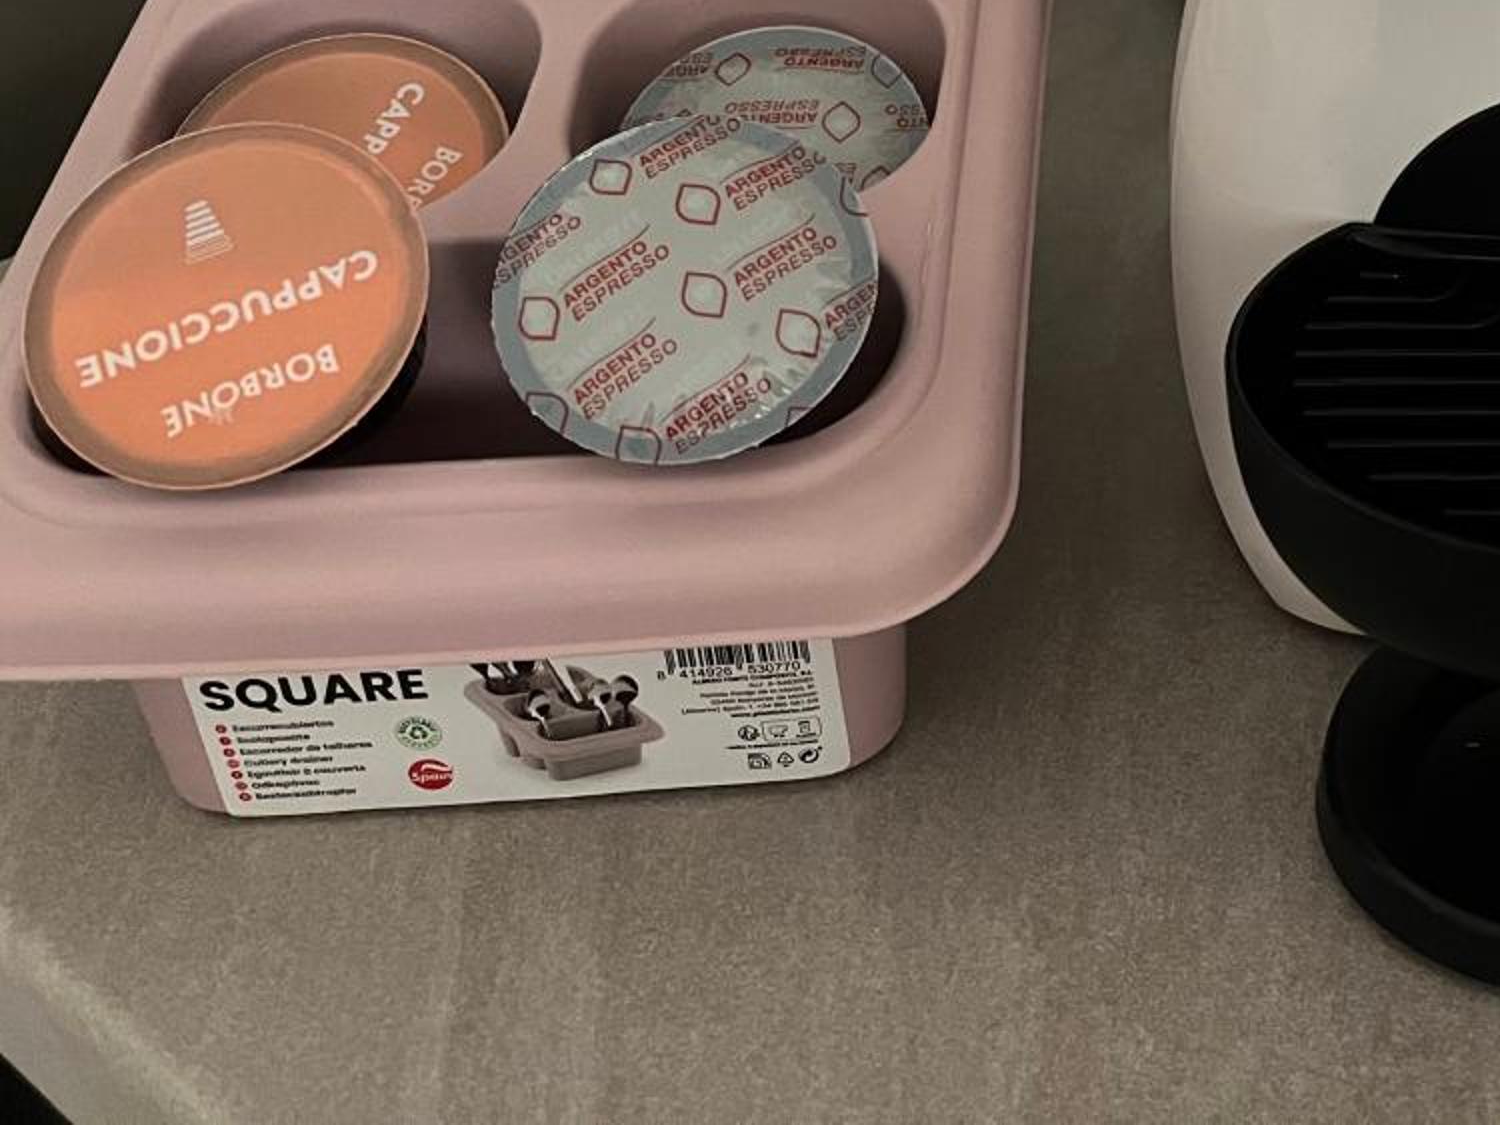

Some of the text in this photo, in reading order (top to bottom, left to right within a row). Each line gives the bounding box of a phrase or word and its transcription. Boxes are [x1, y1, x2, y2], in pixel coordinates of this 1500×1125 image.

[363, 82, 425, 155] CAPP
[644, 118, 741, 180] ESPRESSO
[725, 146, 806, 199] ARGENTO
[563, 240, 648, 309] ARGENTO
[571, 244, 671, 322] ESPRESSO
[734, 227, 817, 288] ARGENTO
[741, 235, 838, 302] ESPRESSO
[74, 249, 379, 389] CAPPUCCIONE
[160, 343, 341, 438] BORBONE
[573, 332, 657, 405] ARGENTO
[581, 338, 678, 420] ESPRESSO
[665, 372, 749, 439] ARGENTO
[674, 377, 772, 455] ESPRESSO
[199, 668, 429, 713] SQUARE
